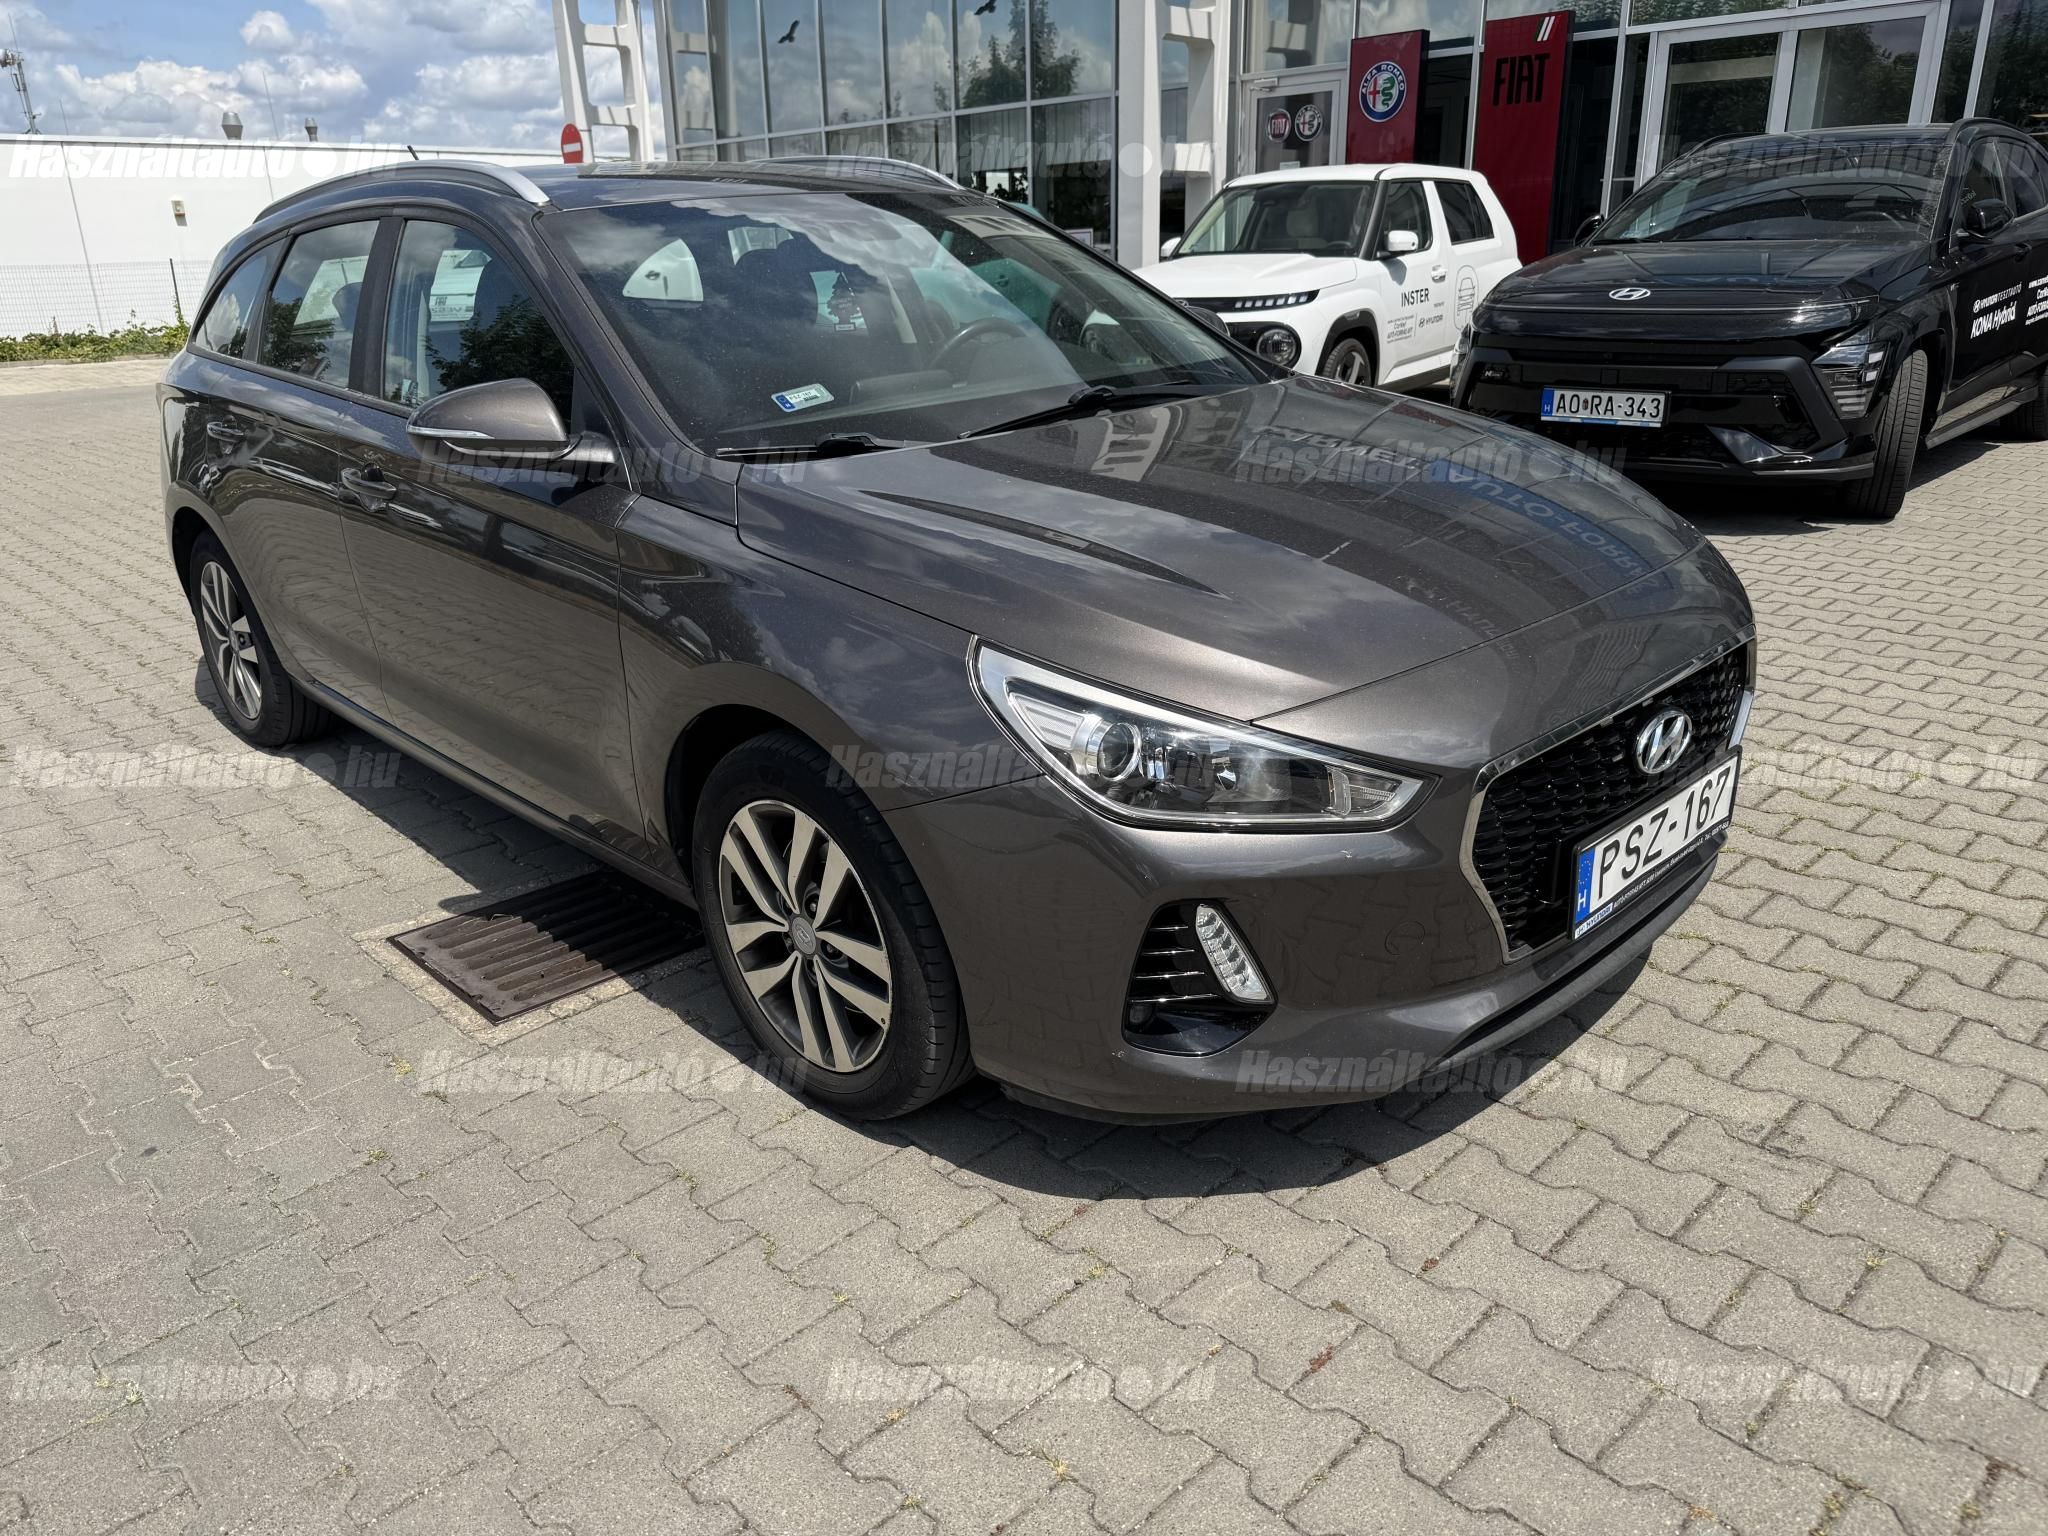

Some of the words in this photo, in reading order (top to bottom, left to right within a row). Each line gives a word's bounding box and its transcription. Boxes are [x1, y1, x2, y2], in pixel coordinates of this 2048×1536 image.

[1362, 69, 1377, 94] ALFA
[1381, 64, 1405, 91] ROMEO
[1493, 53, 1550, 106] FIAT
[1401, 288, 1430, 307] INSTER
[1970, 312, 1993, 339] KONA
[1992, 300, 2017, 330] Hybrid
[1544, 404, 1550, 412] H
[1556, 393, 1580, 414] AO
[1590, 395, 1661, 418] RA-343
[1598, 766, 1731, 899] PSZ-167
[1577, 889, 1587, 912] H
